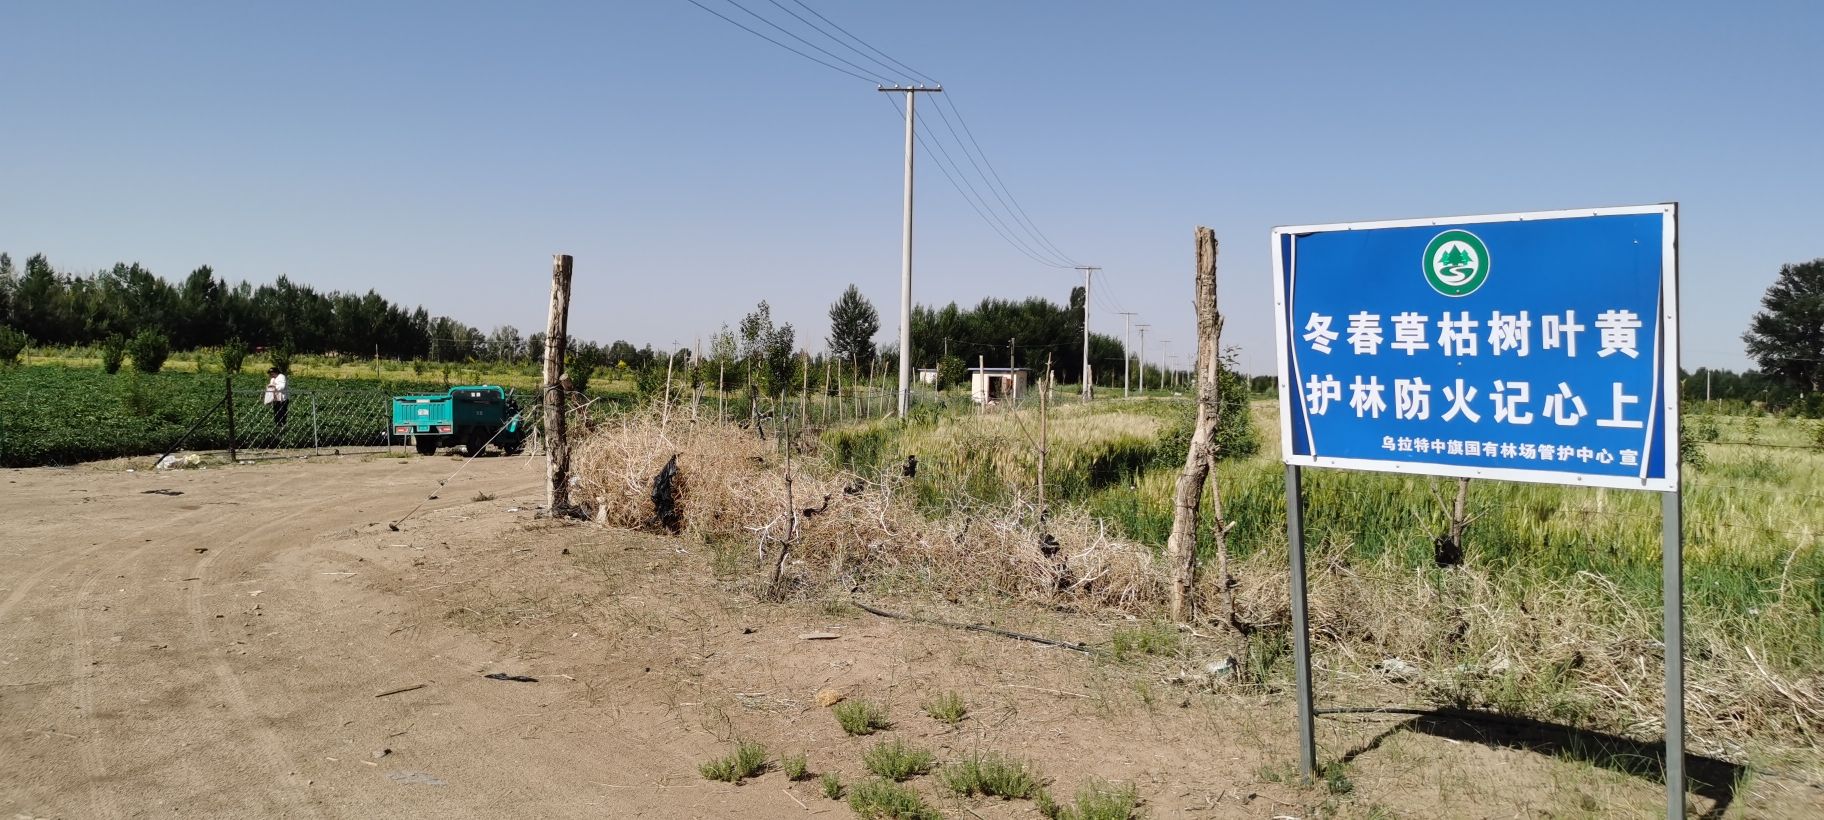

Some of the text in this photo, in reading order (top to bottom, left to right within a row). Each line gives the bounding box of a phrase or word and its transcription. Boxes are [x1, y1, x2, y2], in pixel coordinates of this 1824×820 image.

[1302, 309, 1642, 358] 冬春草枯树叶黄
[1305, 374, 1643, 429] 护林防火记心上
[1381, 435, 1638, 466] 乌拉特中旗国有林场管护中心 宣
